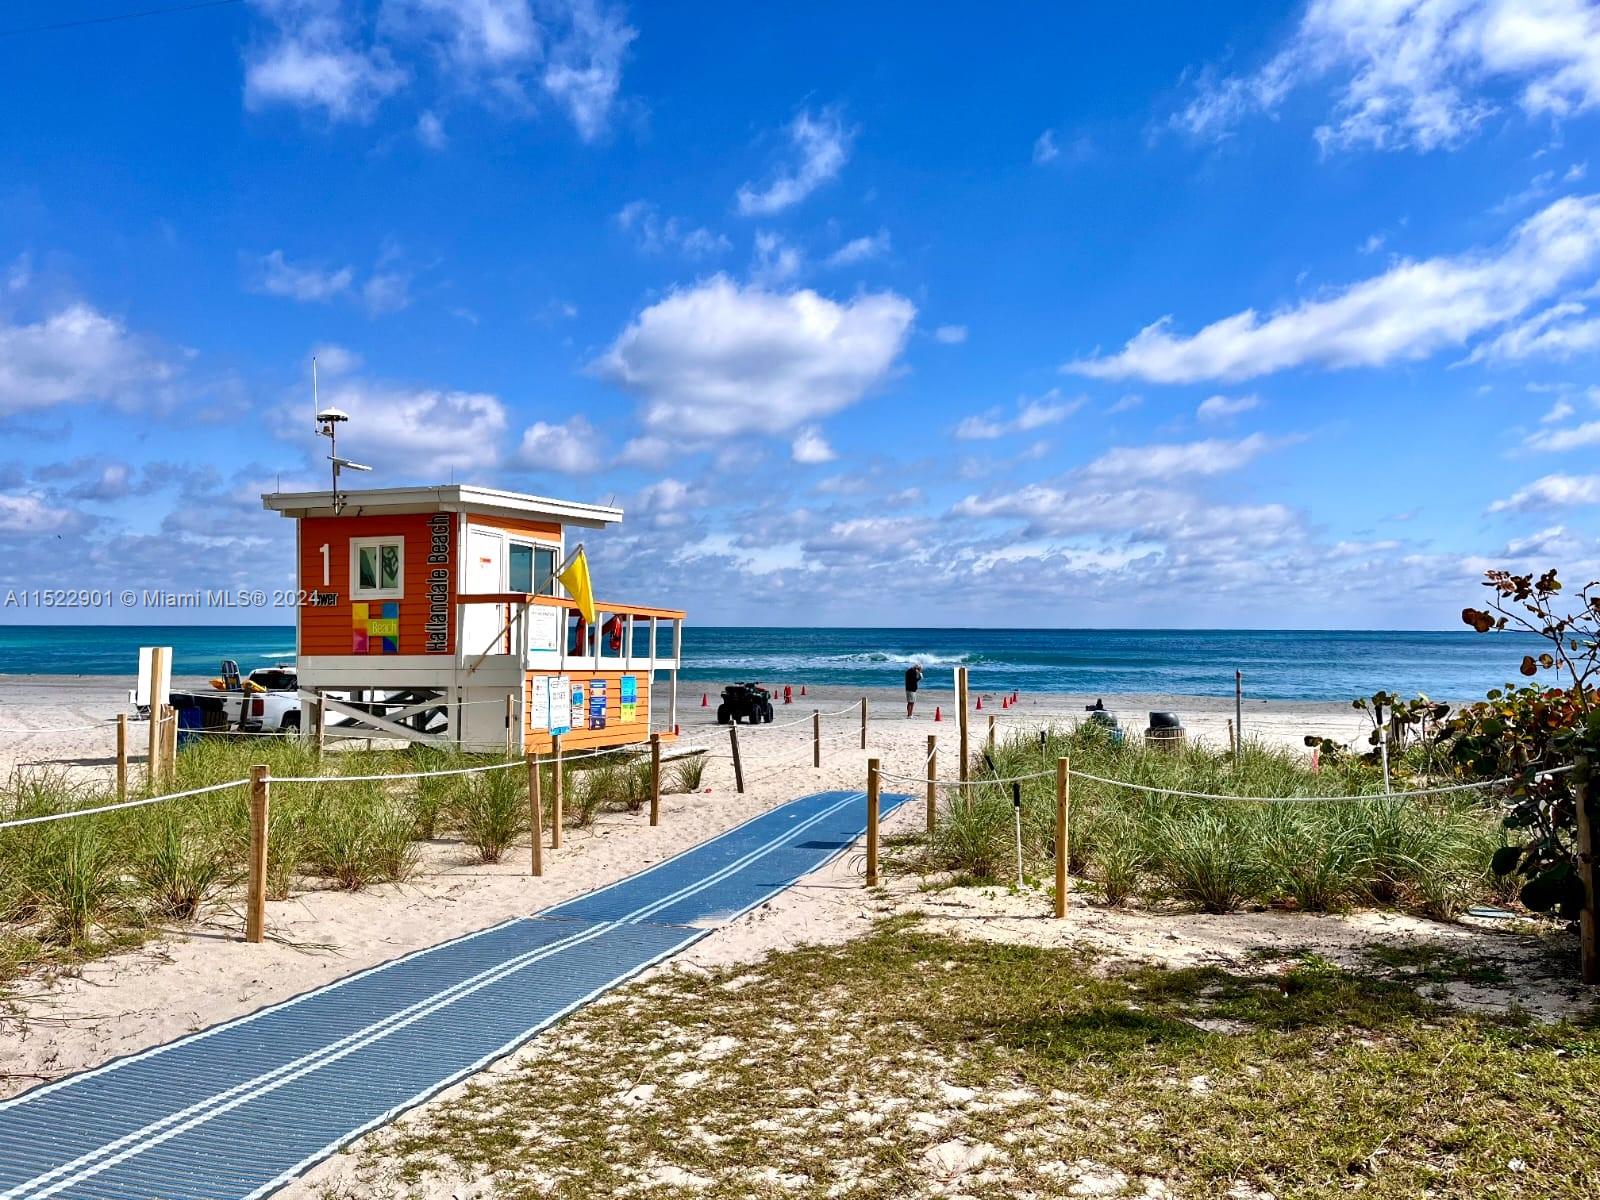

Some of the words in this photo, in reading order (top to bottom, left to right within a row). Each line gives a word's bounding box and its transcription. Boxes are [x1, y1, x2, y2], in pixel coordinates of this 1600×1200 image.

[427, 513, 449, 565] Beach
[320, 543, 330, 586] 1
[372, 621, 397, 634] Beach
[425, 569, 449, 653] Hallandale
